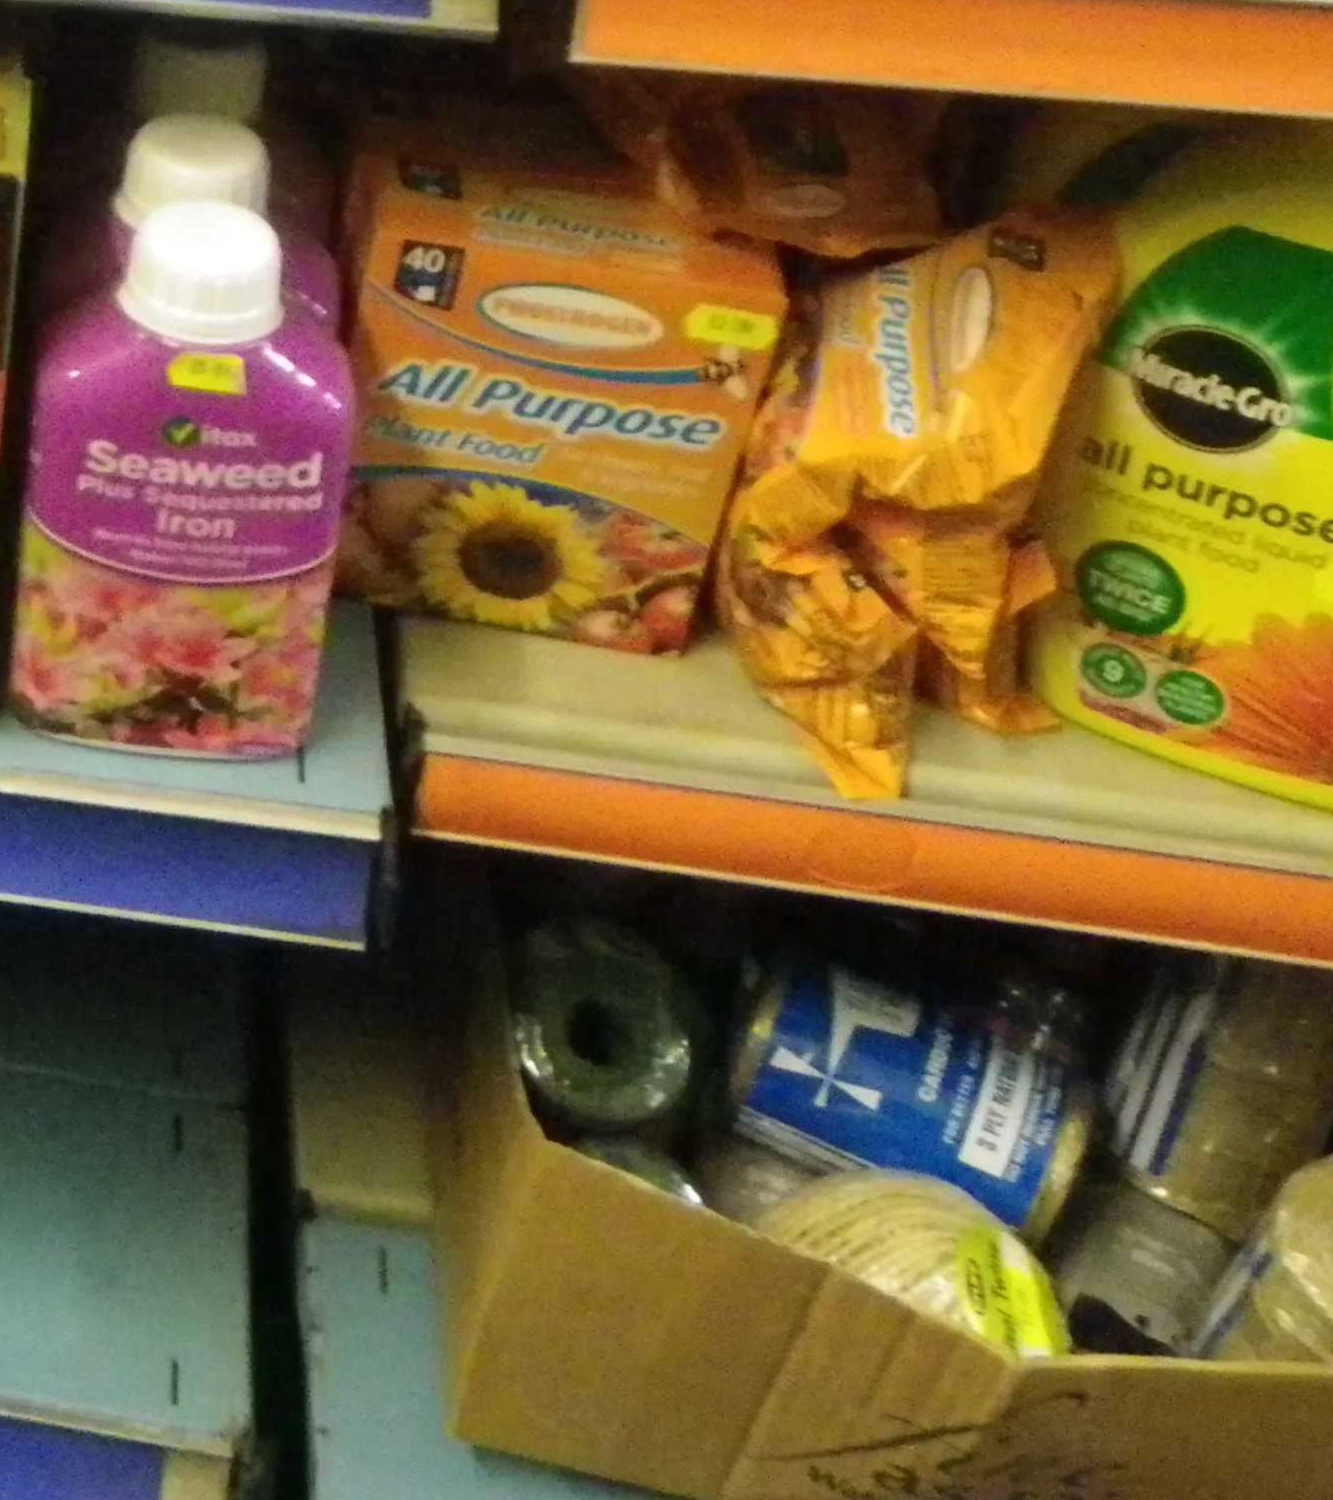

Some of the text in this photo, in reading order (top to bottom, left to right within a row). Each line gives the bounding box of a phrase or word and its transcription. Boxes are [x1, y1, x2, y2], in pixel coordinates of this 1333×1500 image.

[401, 246, 447, 274] 40
[871, 296, 918, 439] Purpose
[377, 362, 723, 447] All Purpose
[85, 439, 323, 491] Seaweed
[458, 431, 546, 464] Food
[1078, 437, 1132, 476] all
[156, 508, 238, 540] Iron
